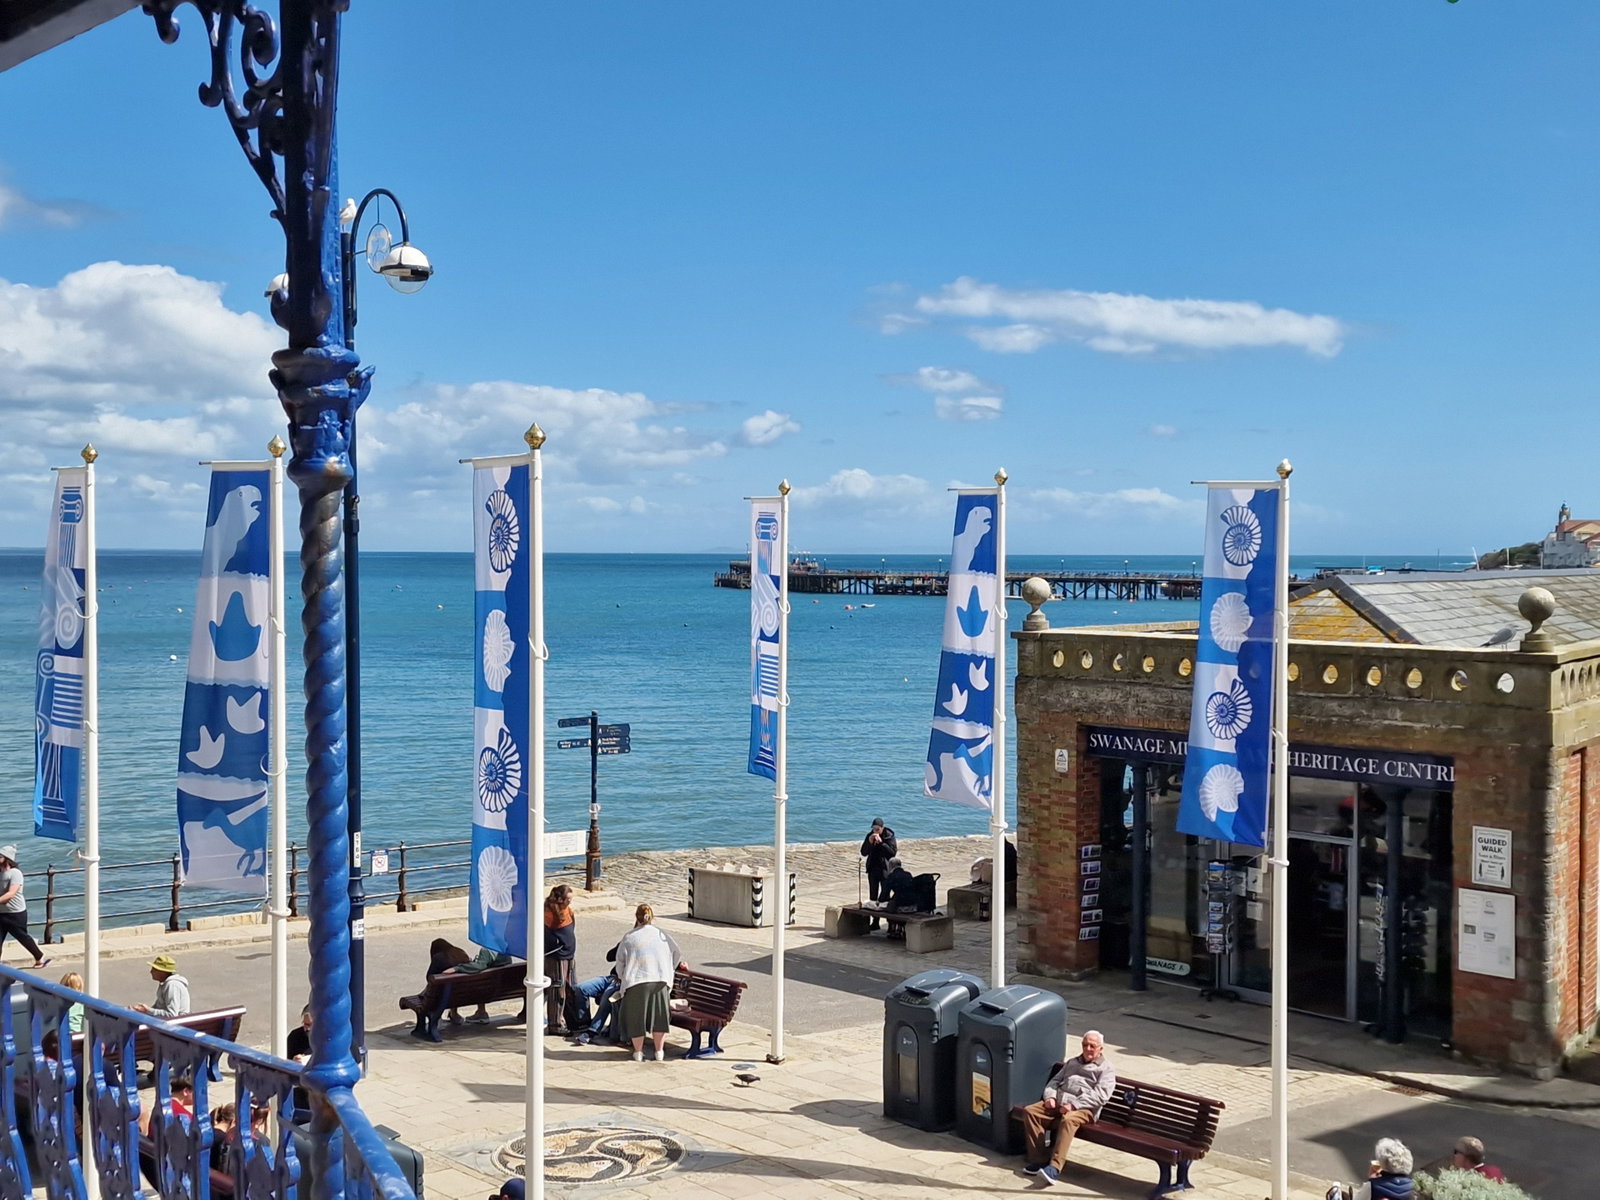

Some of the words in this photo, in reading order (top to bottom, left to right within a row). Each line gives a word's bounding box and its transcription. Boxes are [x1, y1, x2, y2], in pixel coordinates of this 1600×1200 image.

[1089, 733, 1166, 754] SWANAGE
[1288, 751, 1380, 775] HERITAGE
[1477, 837, 1507, 846] GUIDED
[1481, 845, 1503, 854] WALK
